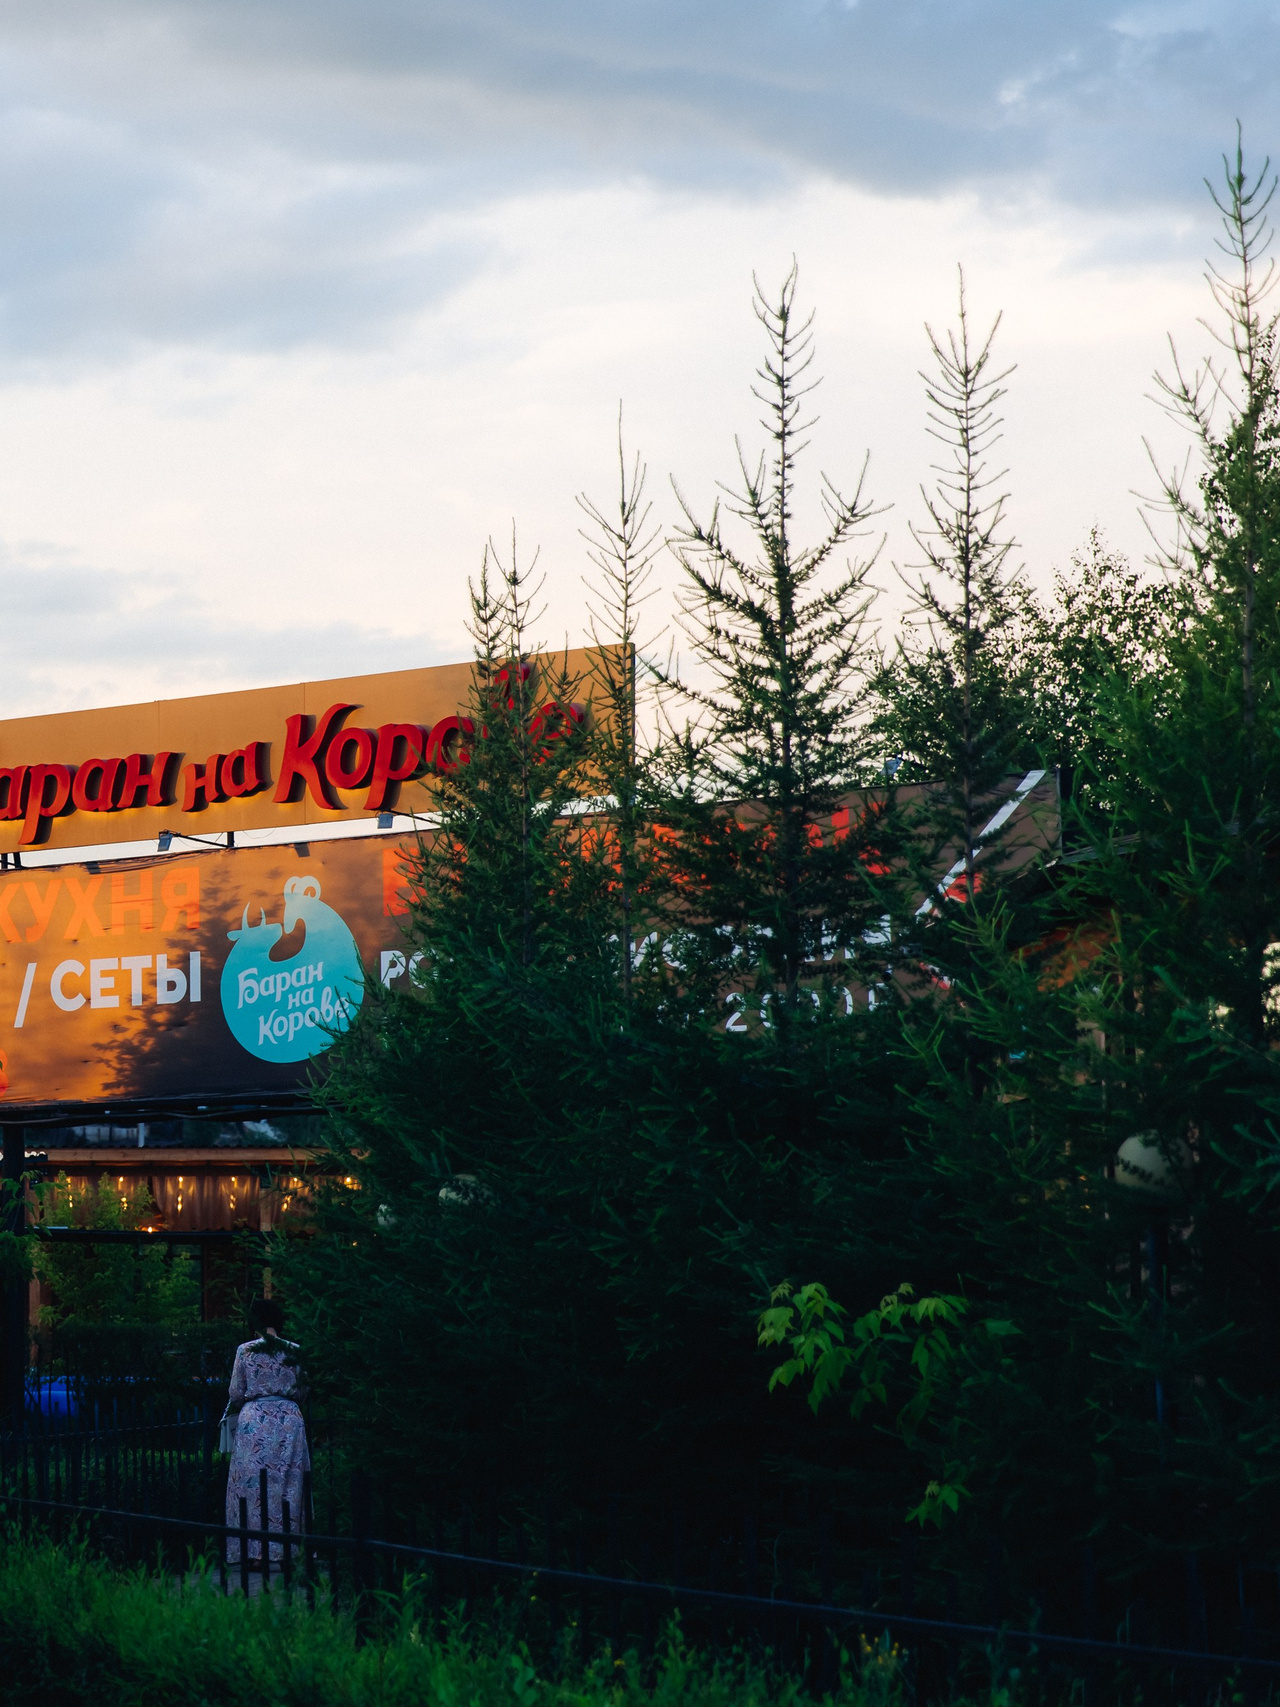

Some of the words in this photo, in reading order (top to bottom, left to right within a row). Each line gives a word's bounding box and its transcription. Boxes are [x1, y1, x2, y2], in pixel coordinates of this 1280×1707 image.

[182, 741, 269, 813] на
[272, 661, 588, 812] Корое
[50, 951, 202, 1012] СЕТЫ
[237, 961, 324, 1009] Баран
[287, 986, 315, 1010] на
[258, 986, 350, 1046] Корове
